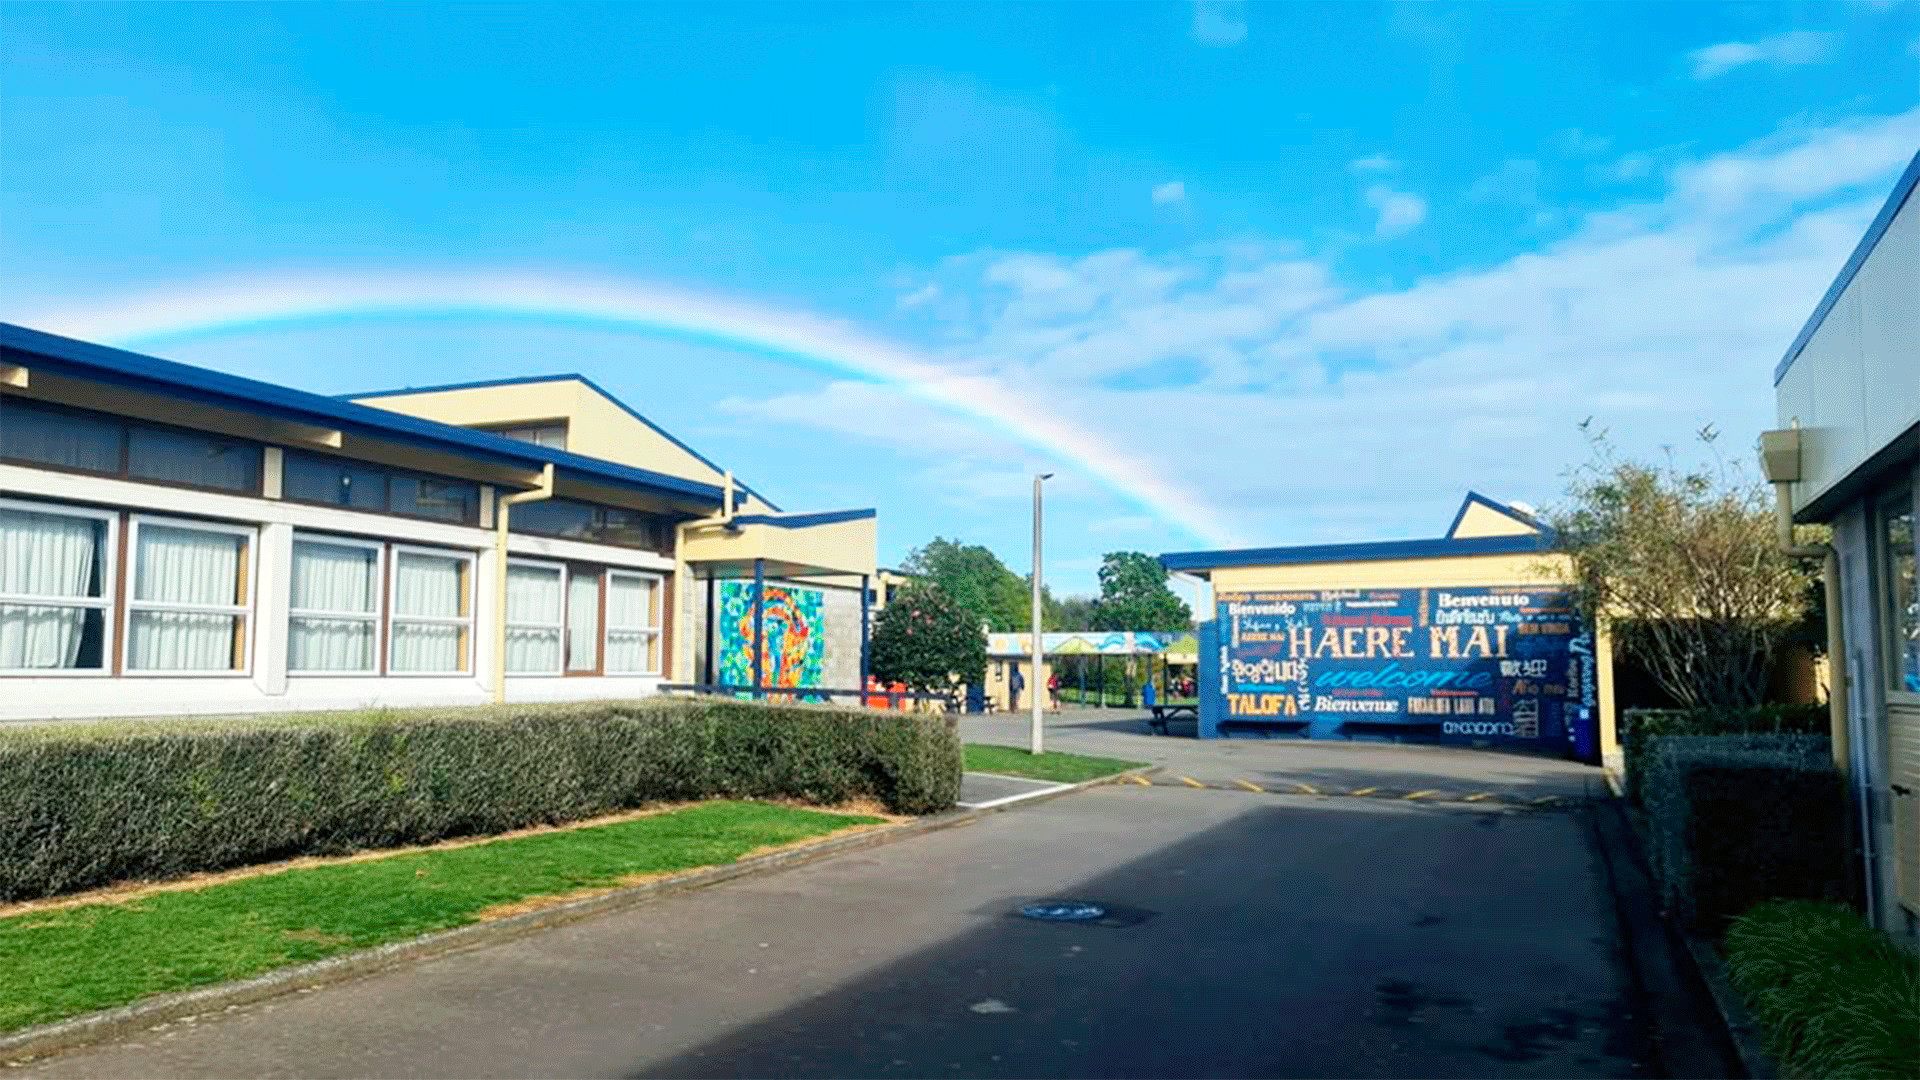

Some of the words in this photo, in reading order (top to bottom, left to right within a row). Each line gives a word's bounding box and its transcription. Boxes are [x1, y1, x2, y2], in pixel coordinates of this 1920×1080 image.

[1228, 601, 1296, 616] Bienvenido
[1439, 592, 1530, 608] Benvenuto
[1287, 626, 1415, 659] HAERE
[1428, 625, 1510, 659] MAI
[1314, 662, 1495, 689] welcome
[1227, 693, 1298, 717] TALOFA
[1314, 694, 1400, 713] Bienvenue
